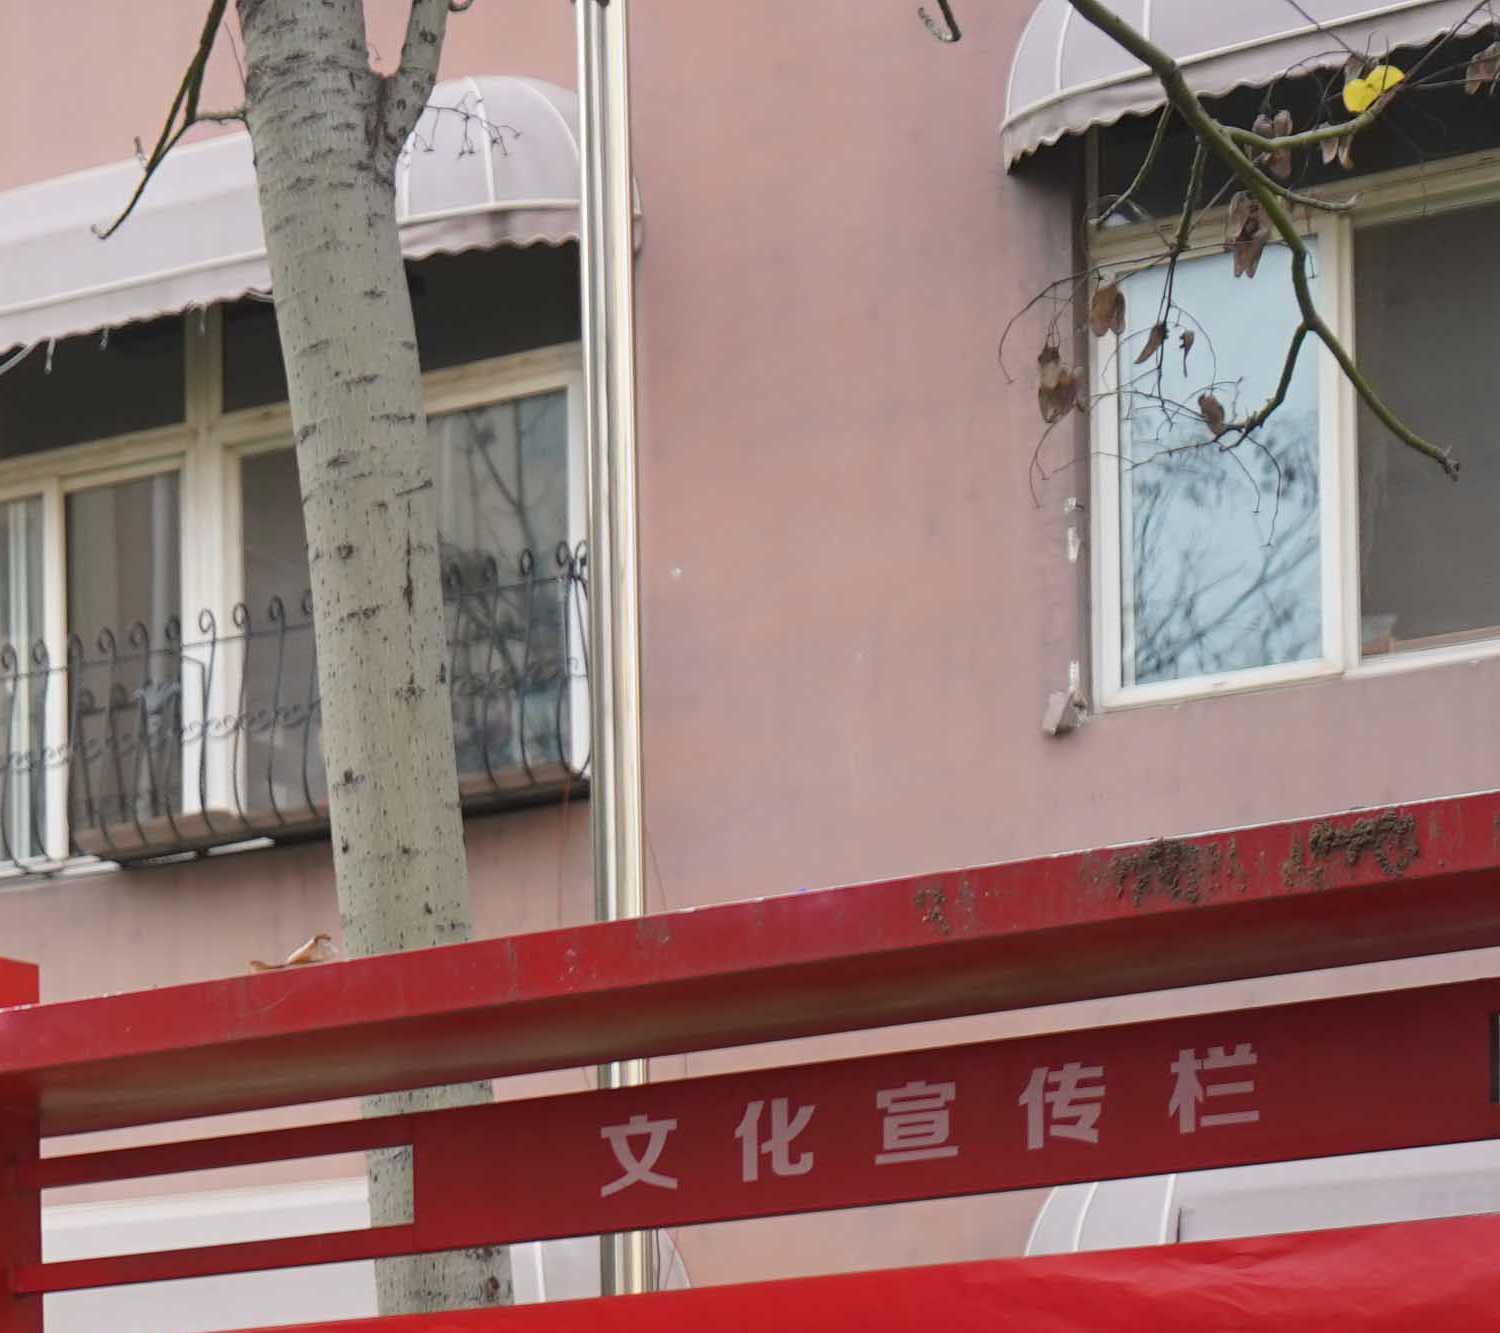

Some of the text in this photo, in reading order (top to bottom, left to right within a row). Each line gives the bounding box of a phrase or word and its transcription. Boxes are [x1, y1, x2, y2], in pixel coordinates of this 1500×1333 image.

[600, 1043, 1260, 1198] 文化宣传栏
